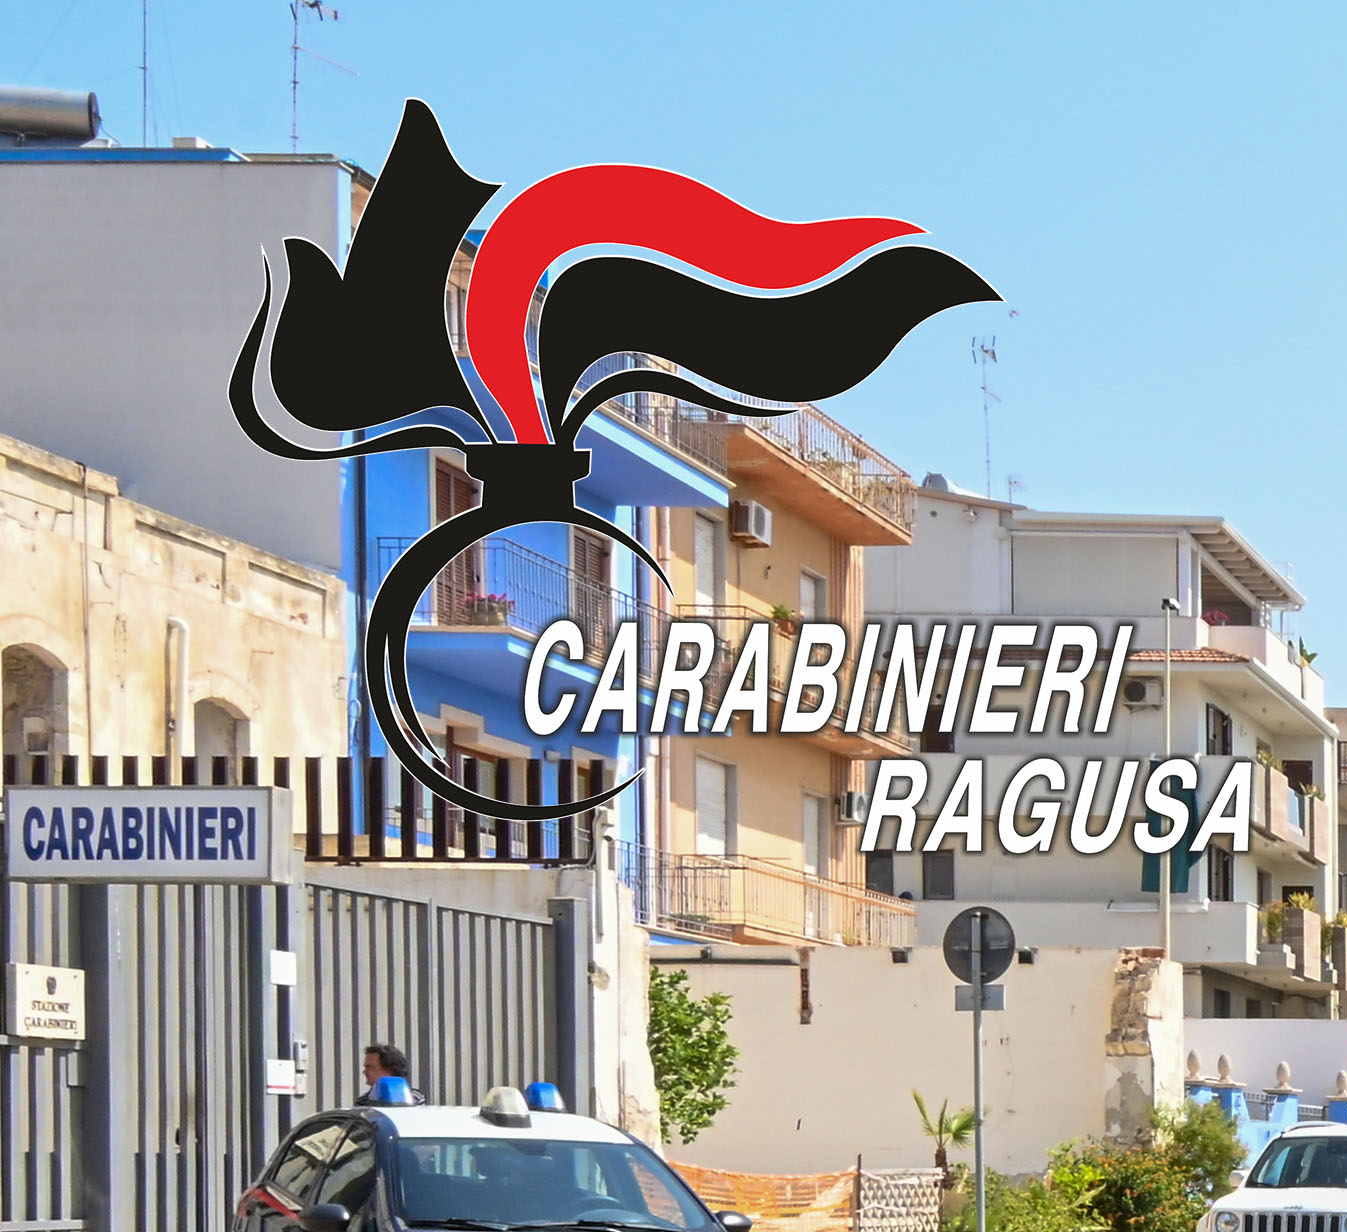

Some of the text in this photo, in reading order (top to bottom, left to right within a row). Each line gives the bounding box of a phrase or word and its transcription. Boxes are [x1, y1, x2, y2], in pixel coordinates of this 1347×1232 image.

[22, 806, 256, 861] CARABINIERI
[32, 1000, 70, 1013] STAZIONE
[24, 1016, 77, 1030] CARABINIERI
